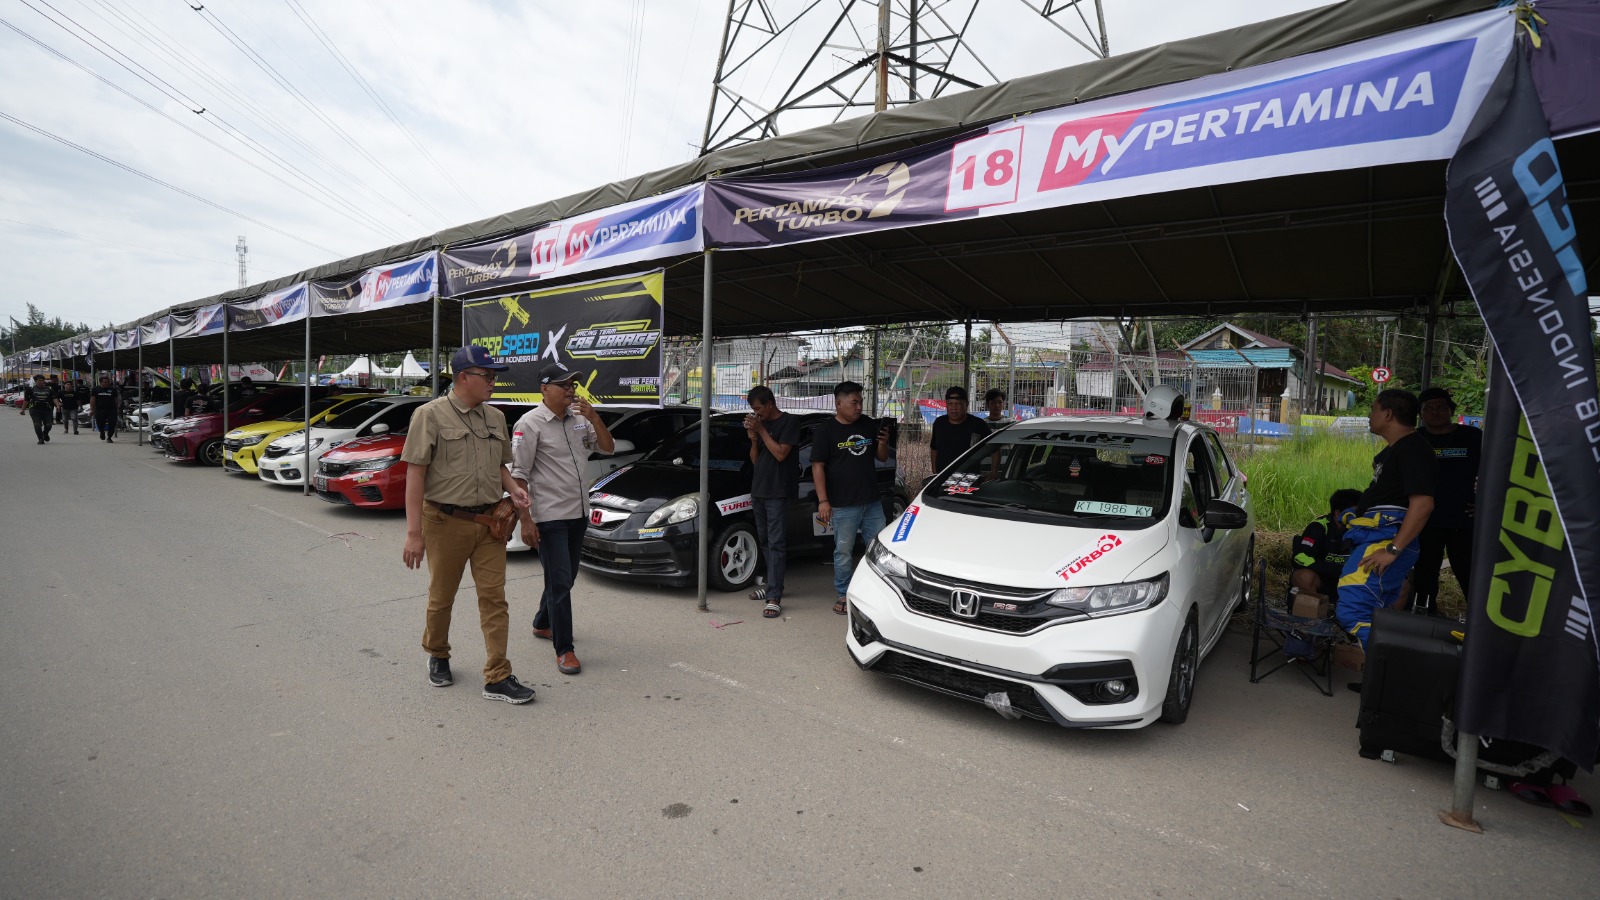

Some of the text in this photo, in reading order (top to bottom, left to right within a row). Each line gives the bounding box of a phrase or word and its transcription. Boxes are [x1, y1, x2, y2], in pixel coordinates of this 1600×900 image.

[955, 148, 1014, 191] 18
[732, 190, 869, 225] PERTAMAX
[775, 206, 863, 232] TURBO
[532, 237, 557, 263] 17
[449, 260, 503, 279] PERTAMAX
[464, 272, 500, 286] TURBO
[500, 332, 540, 356] SPEED
[567, 331, 660, 350] CAS GARAGE
[1076, 501, 1152, 517] KT 1986 KY
[1486, 407, 1566, 638] CYBE
[1059, 543, 1114, 581] TURBO
